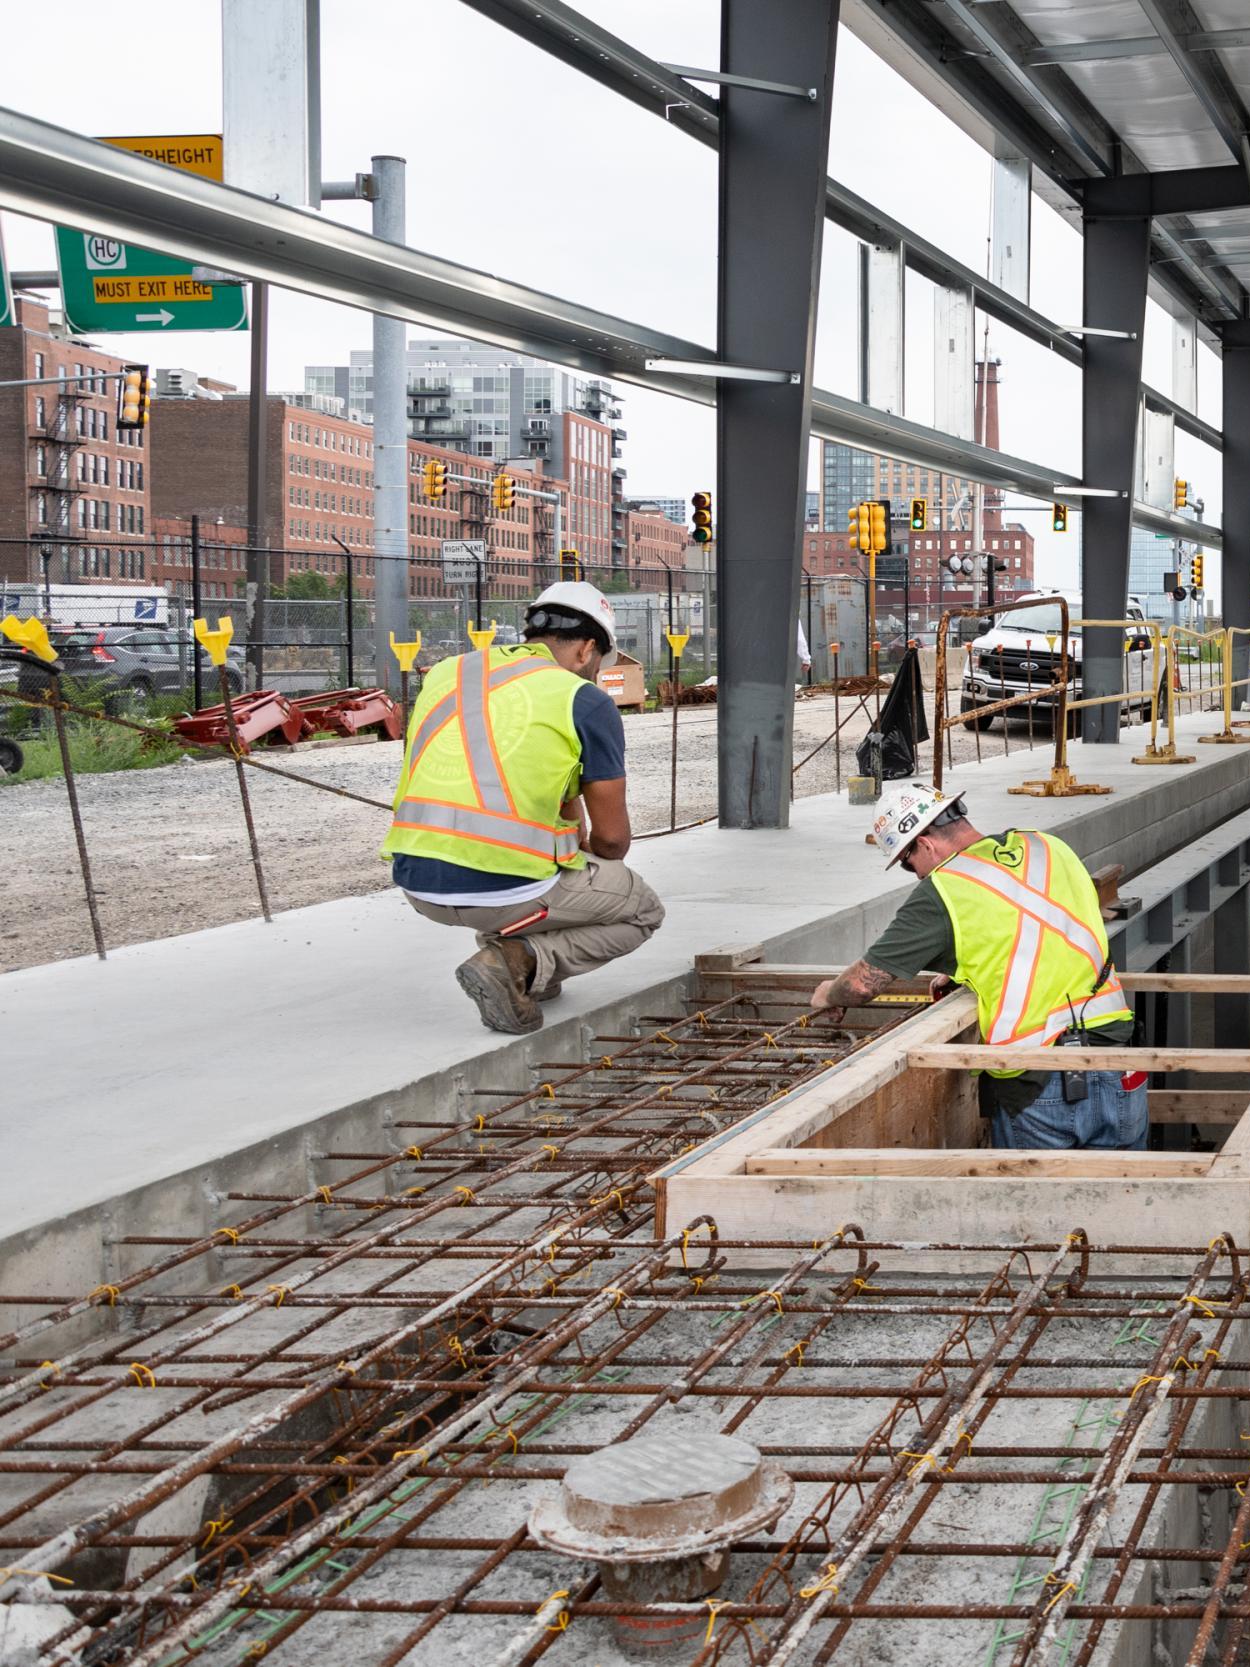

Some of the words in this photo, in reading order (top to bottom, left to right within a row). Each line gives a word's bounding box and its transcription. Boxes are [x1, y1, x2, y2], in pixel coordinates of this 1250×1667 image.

[134, 148, 214, 164] RHEIGHT
[95, 239, 116, 258] HC
[95, 282, 131, 298] MUST
[138, 281, 167, 297] EXIT
[174, 280, 211, 296] HERE
[444, 545, 463, 553] RIGHT
[444, 571, 463, 579] TURN
[465, 570, 484, 578] RIG
